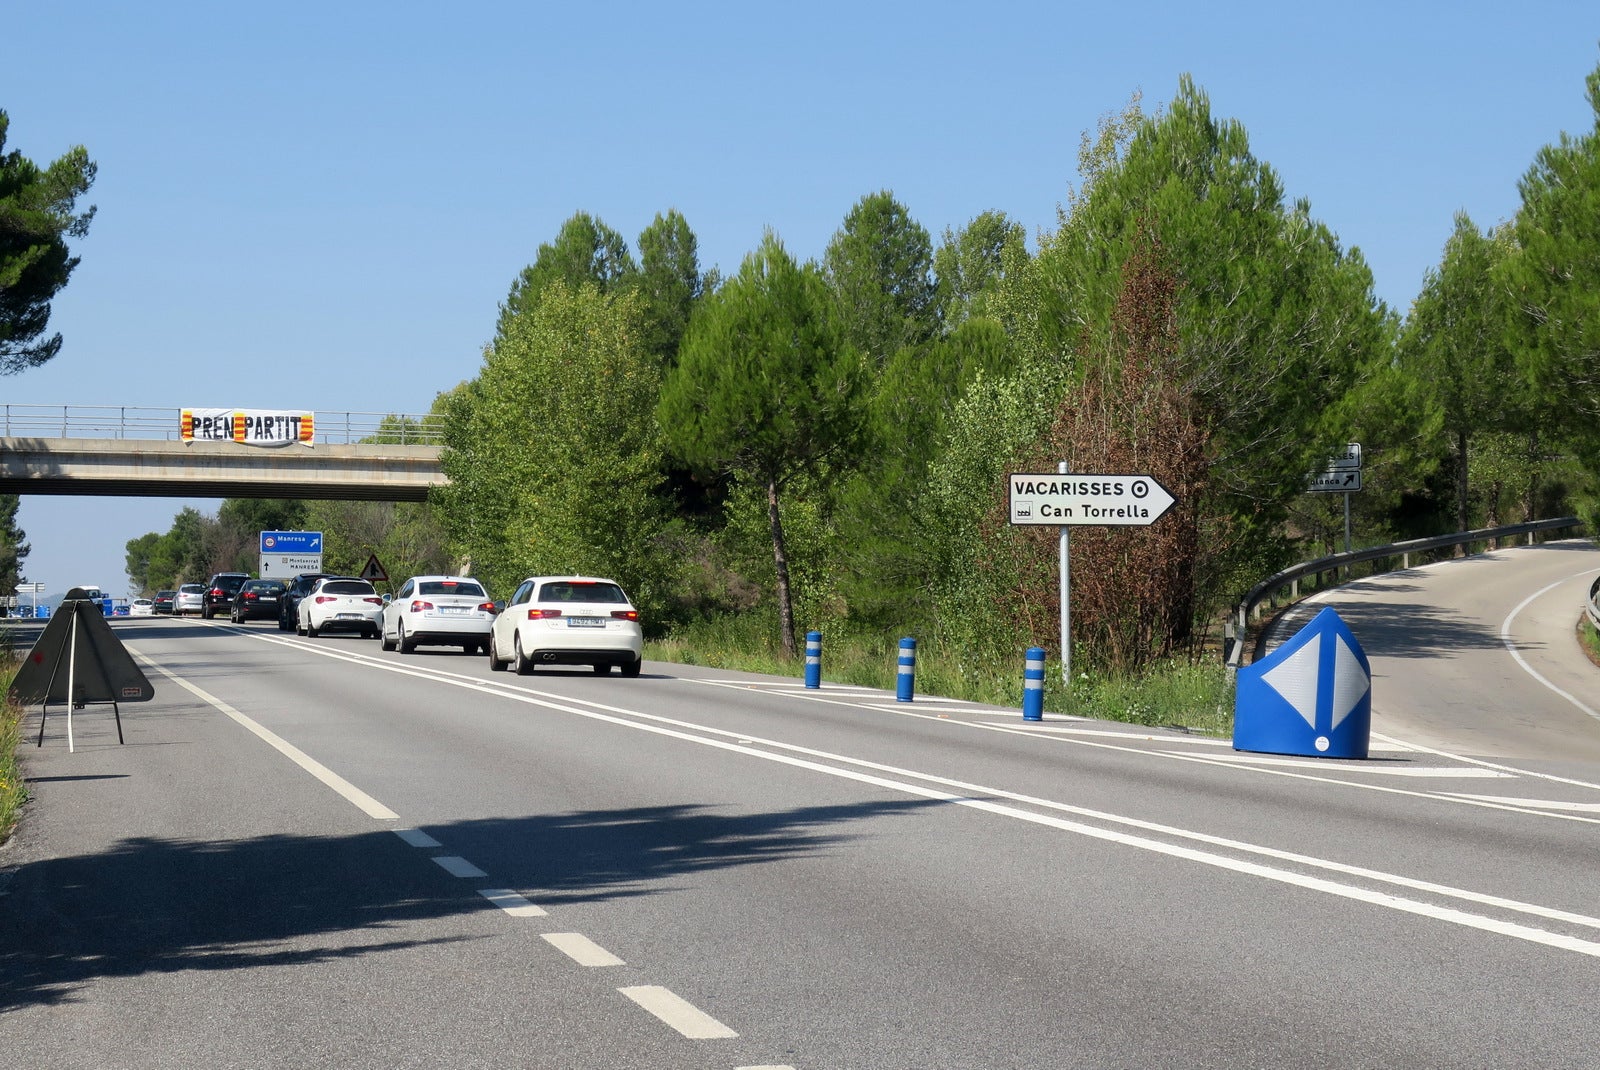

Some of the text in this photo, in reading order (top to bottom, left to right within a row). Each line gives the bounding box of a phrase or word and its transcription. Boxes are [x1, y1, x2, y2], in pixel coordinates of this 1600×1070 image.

[191, 416, 301, 440] PREN PARTIT
[1015, 482, 1124, 496] VACARISSES
[1040, 504, 1149, 518] Can Torrella
